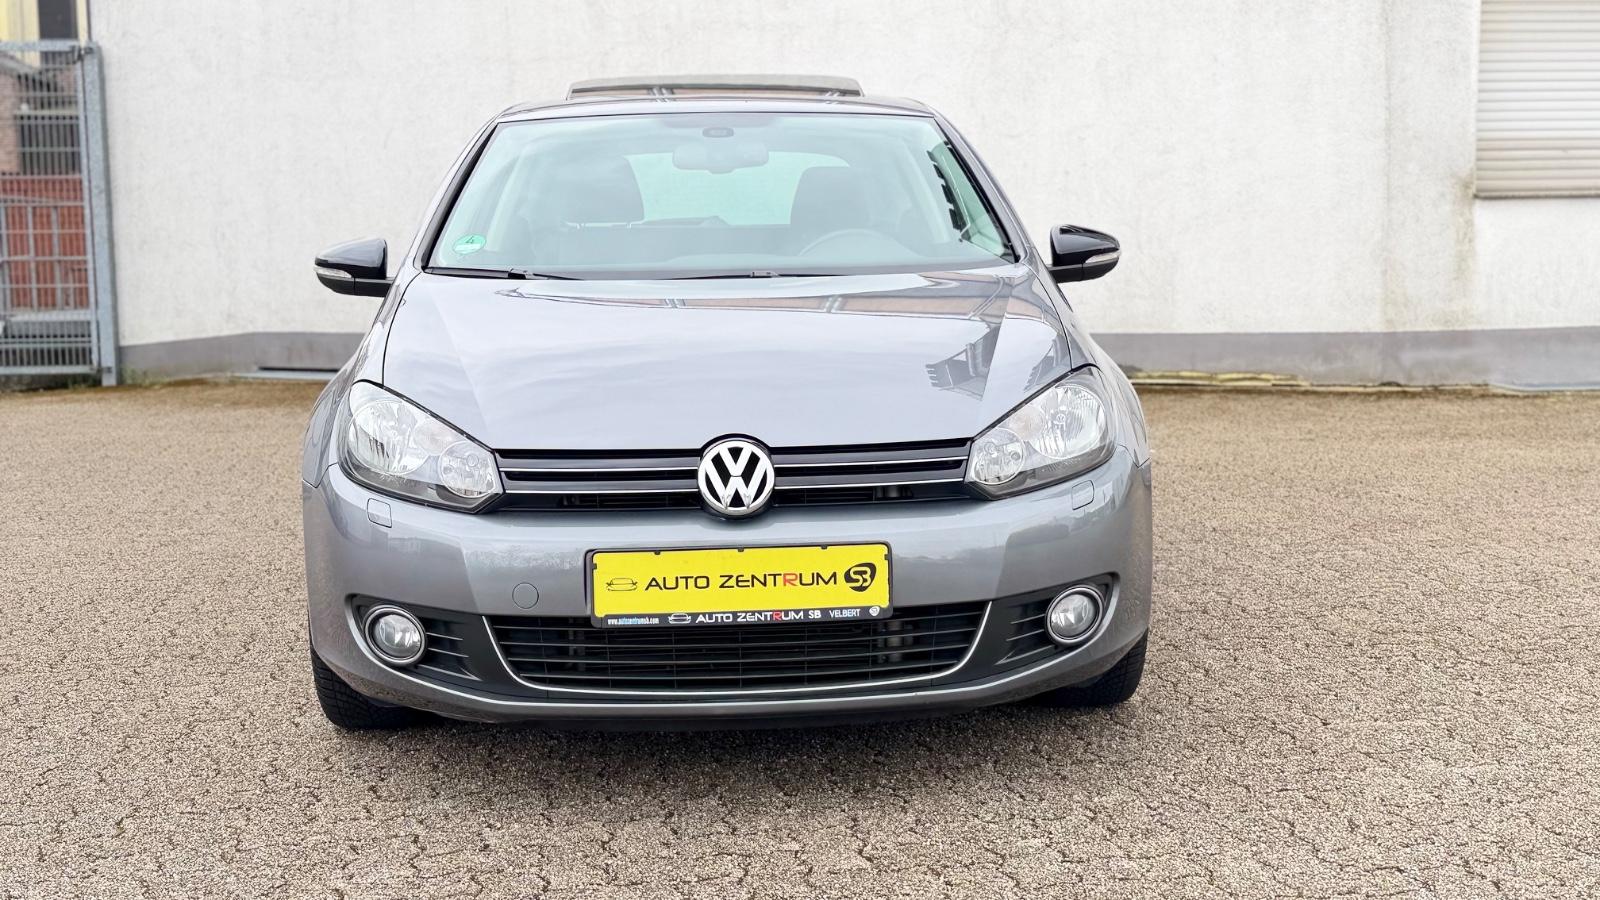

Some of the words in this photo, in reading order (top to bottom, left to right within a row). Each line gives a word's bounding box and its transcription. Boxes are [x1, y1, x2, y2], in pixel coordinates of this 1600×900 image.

[698, 440, 775, 515] VW
[645, 575, 710, 591] AUTO
[719, 571, 837, 589] ZENTRUM
[695, 613, 733, 624] AUTO
[737, 610, 804, 622] ZENTRUM
[808, 609, 822, 619] SB
[829, 608, 861, 618] VELBERT
